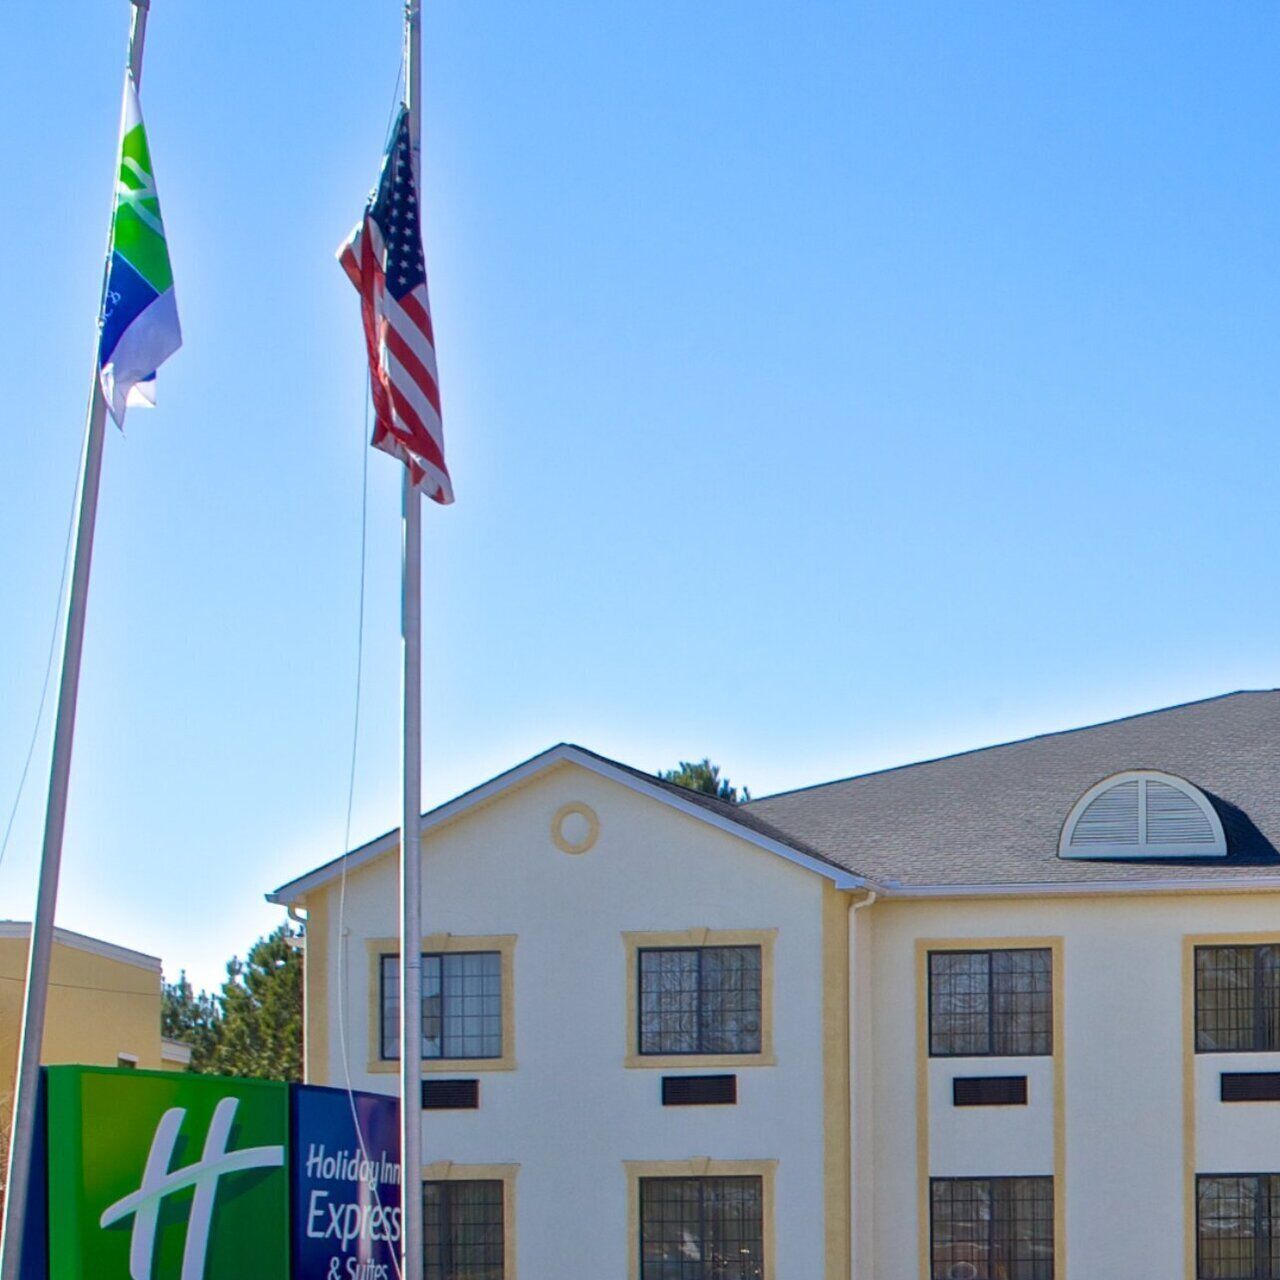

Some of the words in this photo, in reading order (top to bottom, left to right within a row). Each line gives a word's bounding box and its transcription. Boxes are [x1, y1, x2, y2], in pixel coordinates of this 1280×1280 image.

[306, 1143, 378, 1190] Holiday
[380, 1150, 401, 1184] Inn
[306, 1190, 401, 1252] Express
